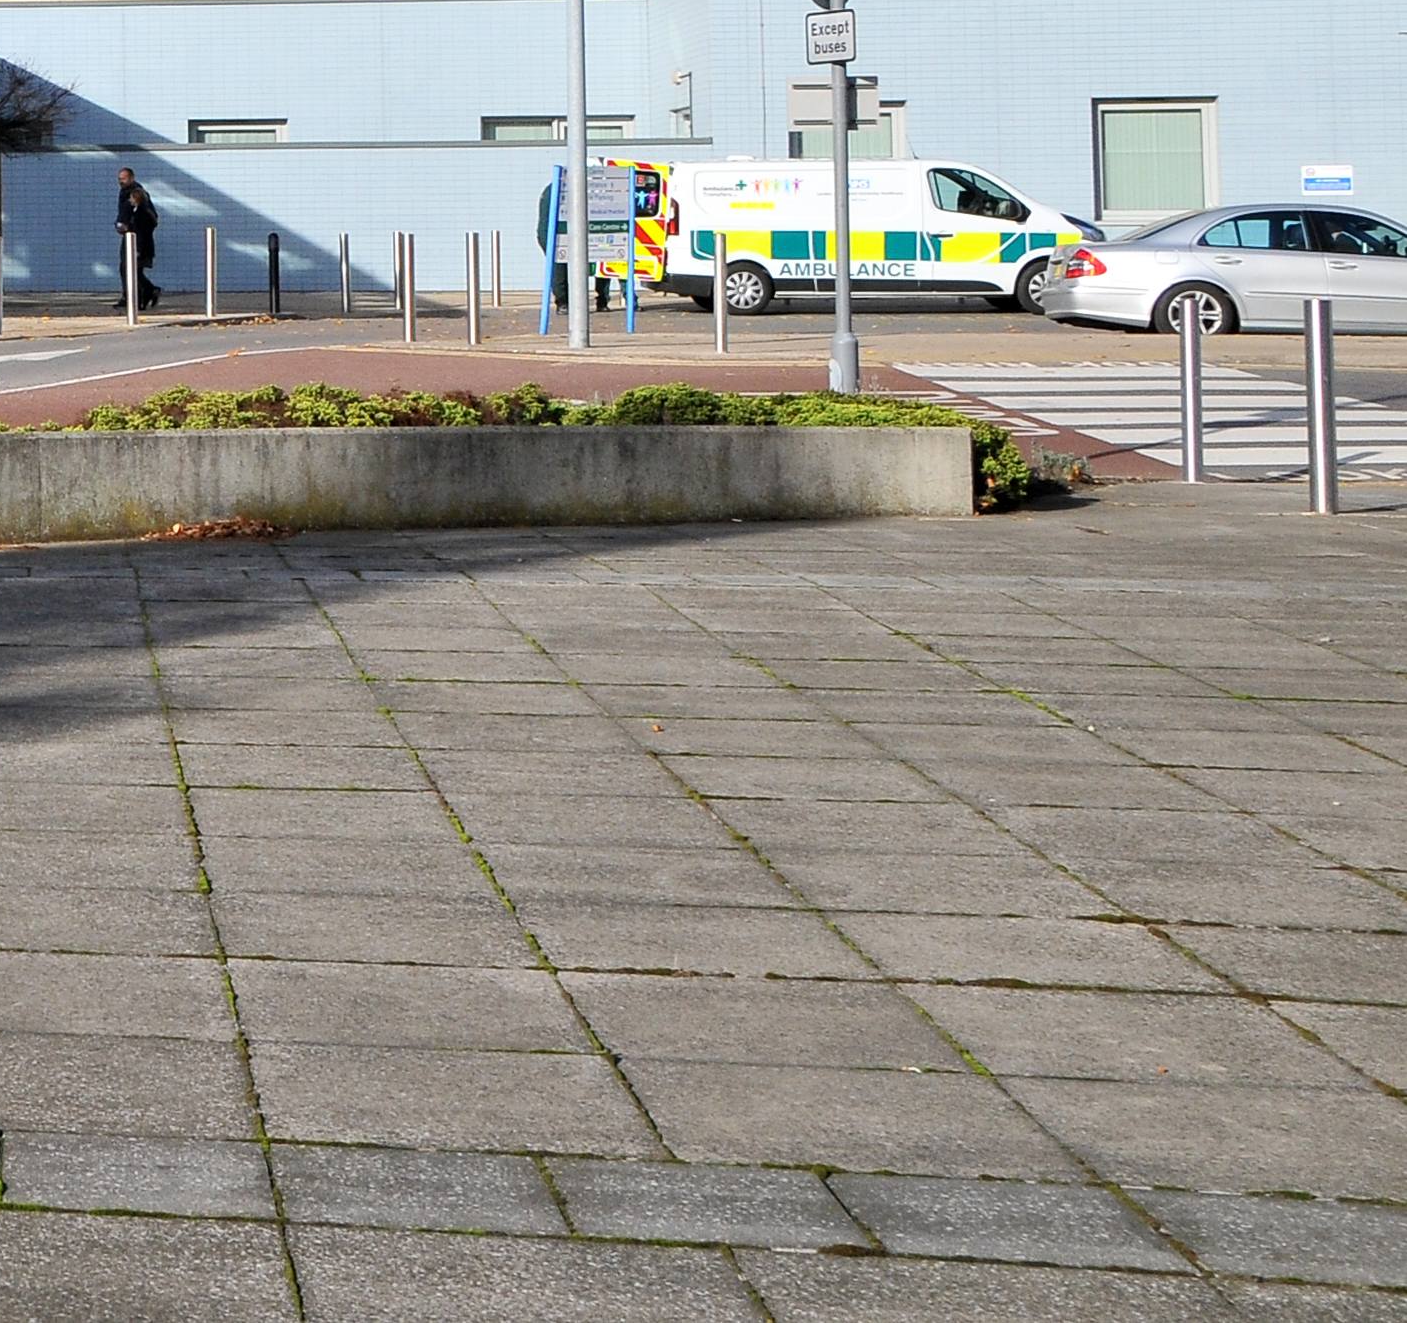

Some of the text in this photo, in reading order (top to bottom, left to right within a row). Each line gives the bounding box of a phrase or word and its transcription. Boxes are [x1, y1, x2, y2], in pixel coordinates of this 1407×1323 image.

[811, 20, 850, 37] Except
[814, 39, 847, 54] buses
[779, 263, 916, 277] AMBUANCE
